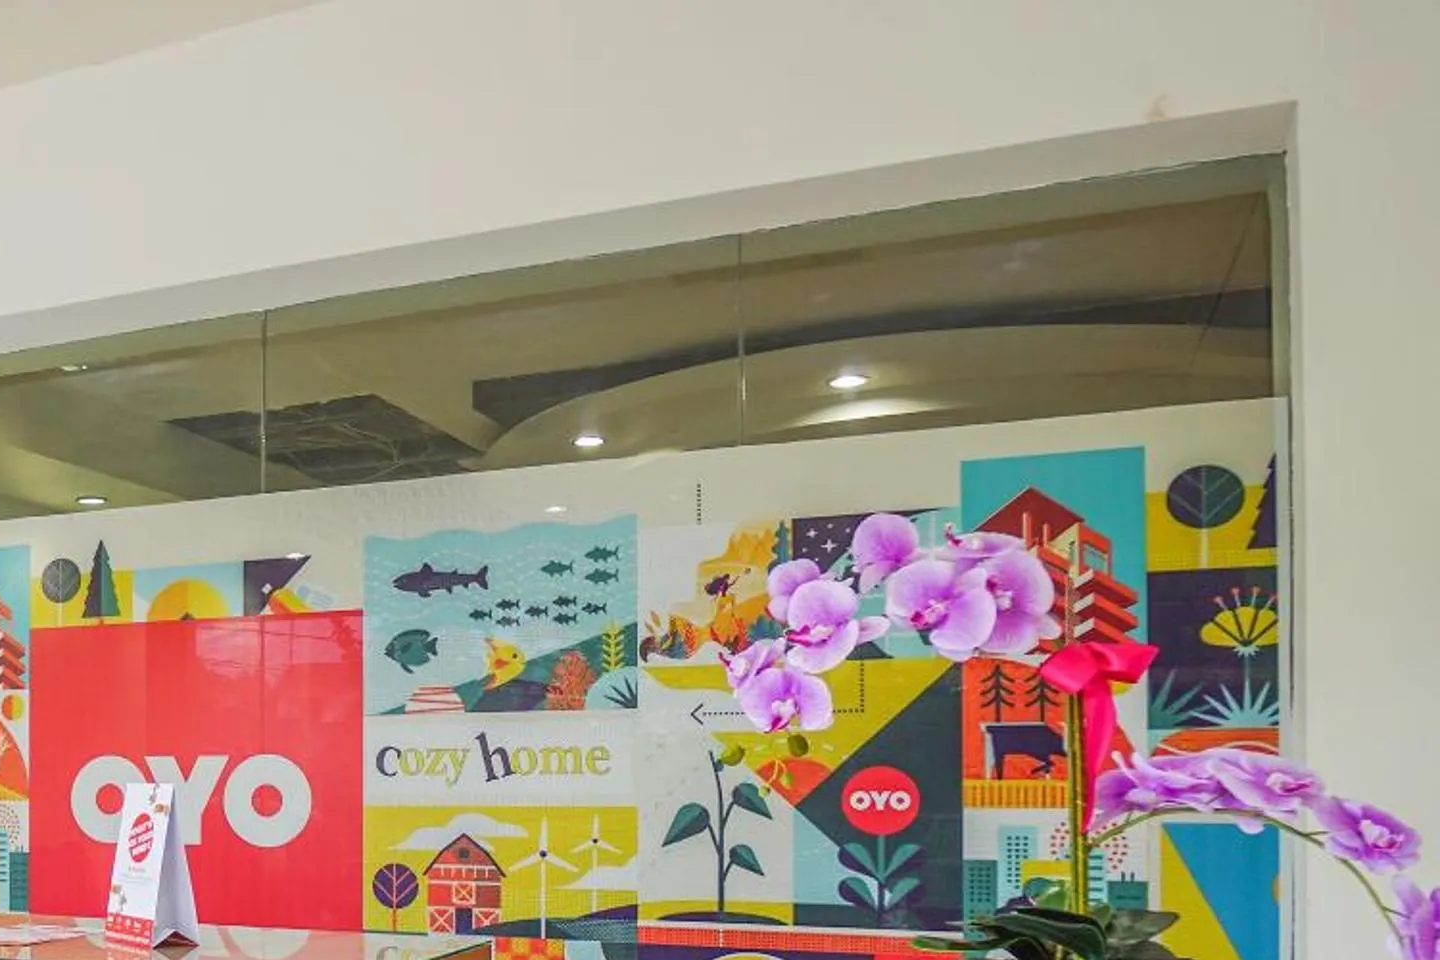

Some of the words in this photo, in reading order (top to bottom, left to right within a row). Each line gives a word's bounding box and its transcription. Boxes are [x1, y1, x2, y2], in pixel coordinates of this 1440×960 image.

[474, 731, 612, 783] home
[70, 753, 312, 848] OYO
[849, 789, 912, 812] OYO
